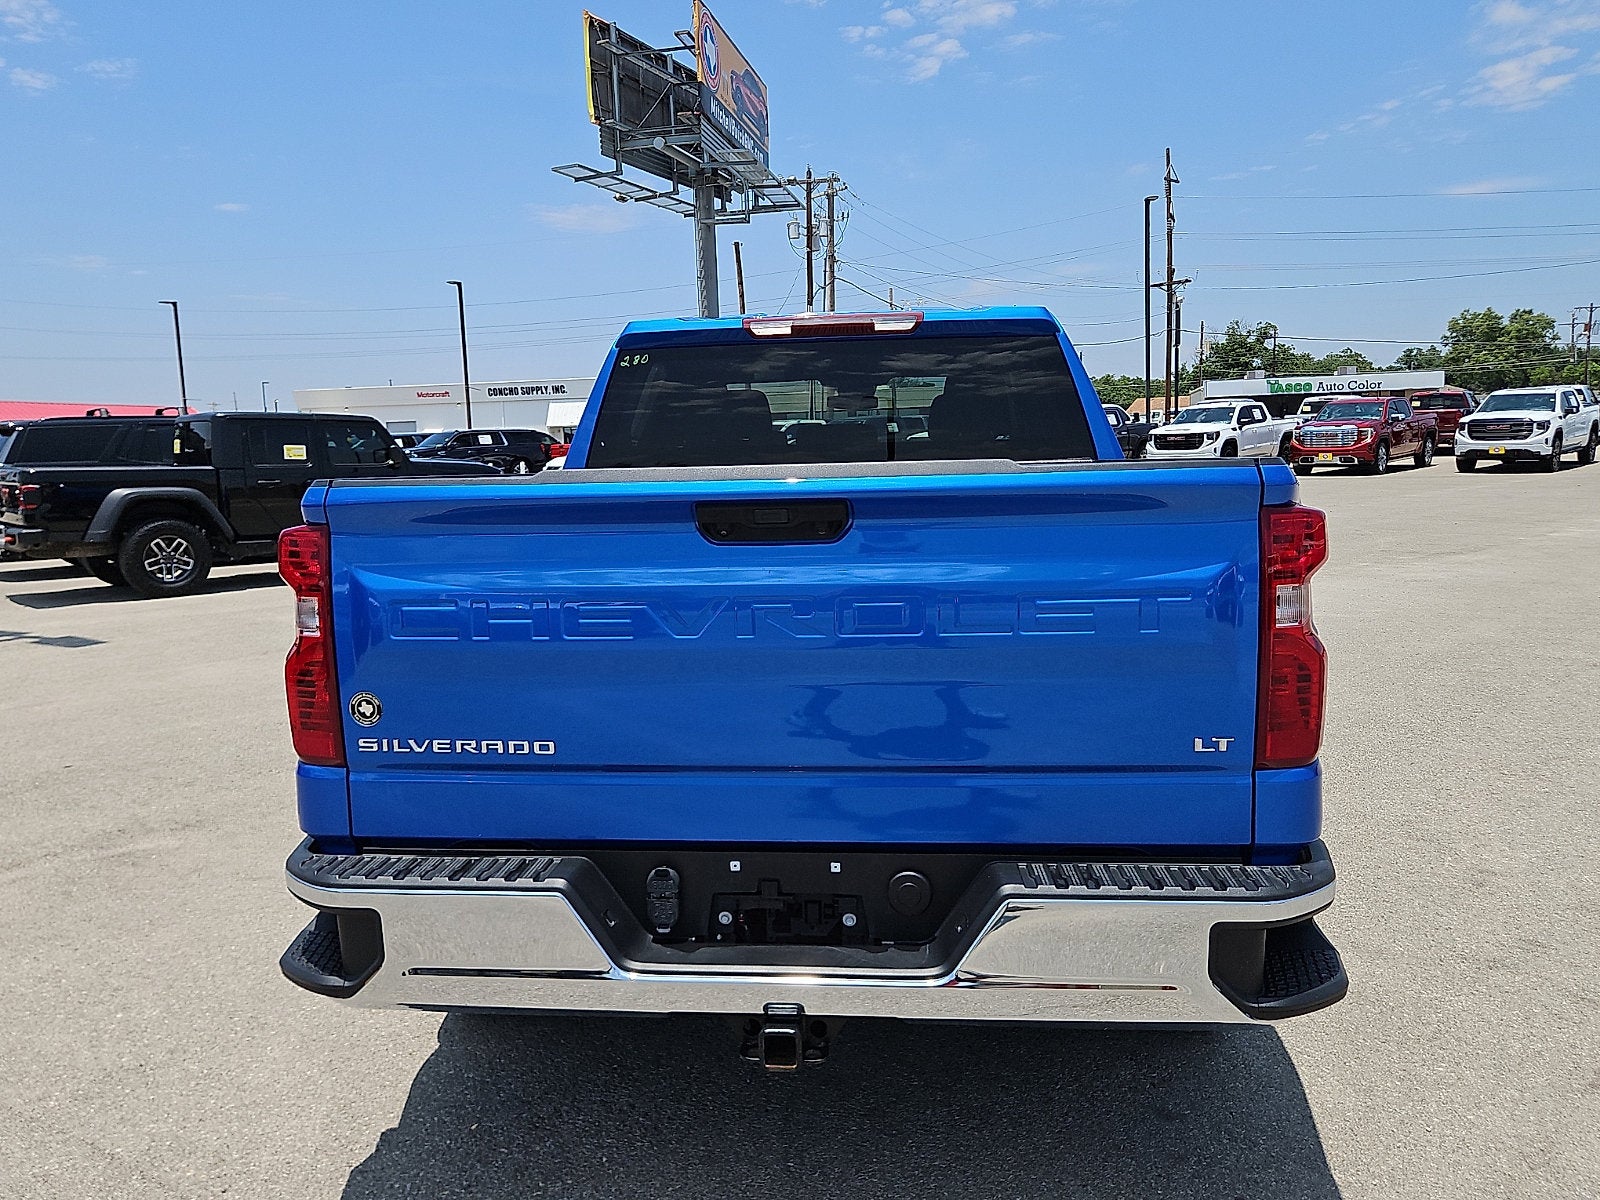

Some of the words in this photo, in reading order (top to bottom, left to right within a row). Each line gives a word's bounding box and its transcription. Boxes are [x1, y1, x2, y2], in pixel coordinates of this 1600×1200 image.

[620, 354, 649, 367] 280
[487, 387, 519, 397] CONCHO
[520, 385, 551, 396] SUPPLY,
[552, 385, 568, 394] INC.
[1266, 380, 1313, 393] TASCO
[1316, 381, 1345, 392] Auto
[1347, 379, 1383, 391] Color
[389, 592, 1192, 641] CHEVROLET
[358, 738, 556, 755] SILVERADO
[1194, 738, 1235, 751] LT
